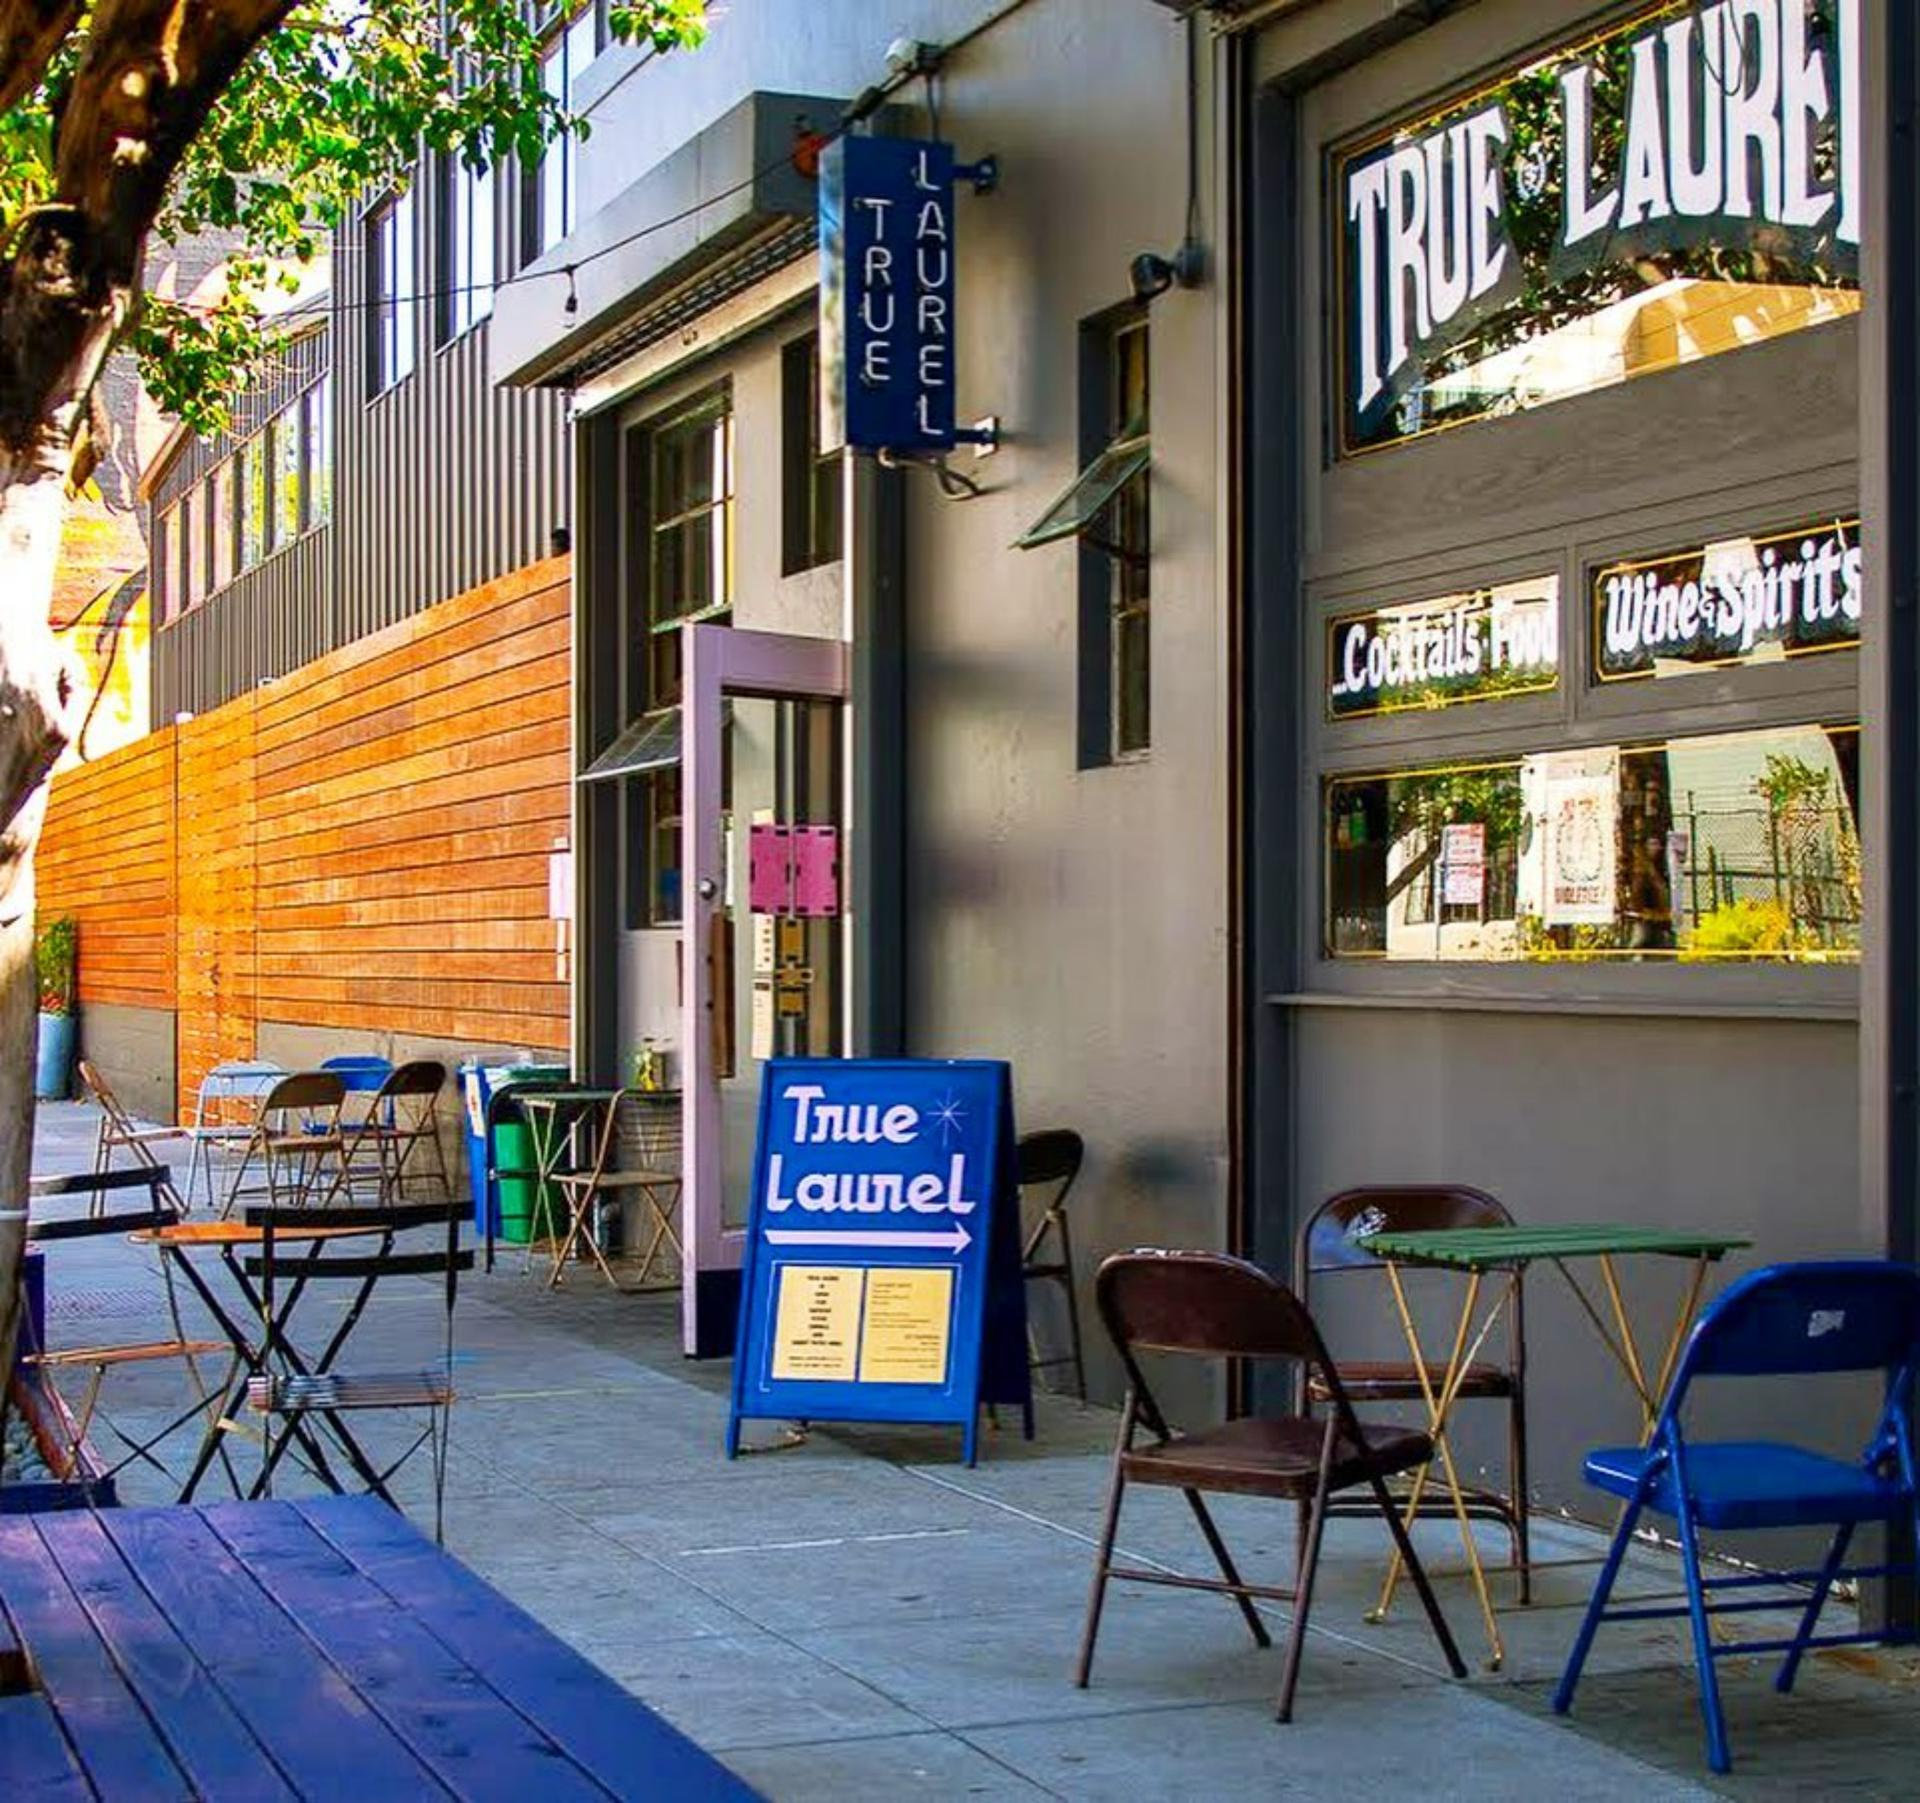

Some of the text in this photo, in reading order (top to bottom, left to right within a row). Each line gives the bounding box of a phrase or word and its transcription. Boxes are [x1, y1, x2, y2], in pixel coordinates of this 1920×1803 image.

[863, 198, 895, 381] TRUE
[915, 150, 947, 435] LAUREL
[1349, 106, 1508, 413] TRUE
[1333, 608, 1481, 694] Cocktails
[1606, 573, 1700, 654] Wine
[783, 1085, 919, 1144] True
[766, 1153, 977, 1214] Laurel
